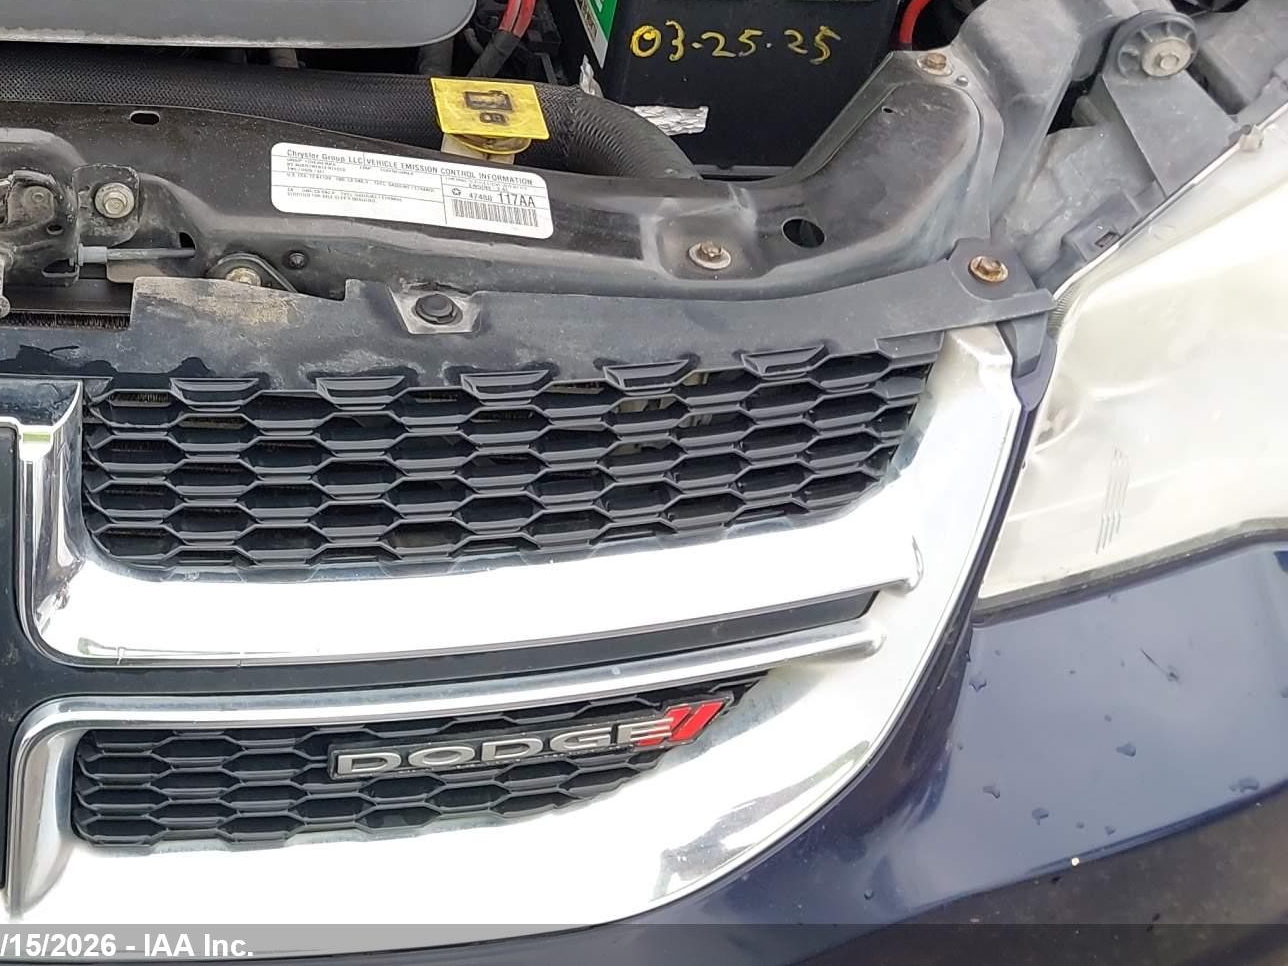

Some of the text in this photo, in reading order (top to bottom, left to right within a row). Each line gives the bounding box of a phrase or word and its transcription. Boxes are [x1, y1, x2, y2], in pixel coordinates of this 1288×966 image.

[321, 153, 346, 163] Group
[348, 155, 363, 164] LLC
[366, 158, 398, 169] VEHICLE
[400, 162, 438, 174] EMISSION
[440, 167, 476, 179] CONTROL
[478, 172, 533, 186] INFORMATION
[498, 192, 536, 208] 117AA
[337, 717, 673, 775] DODGE
